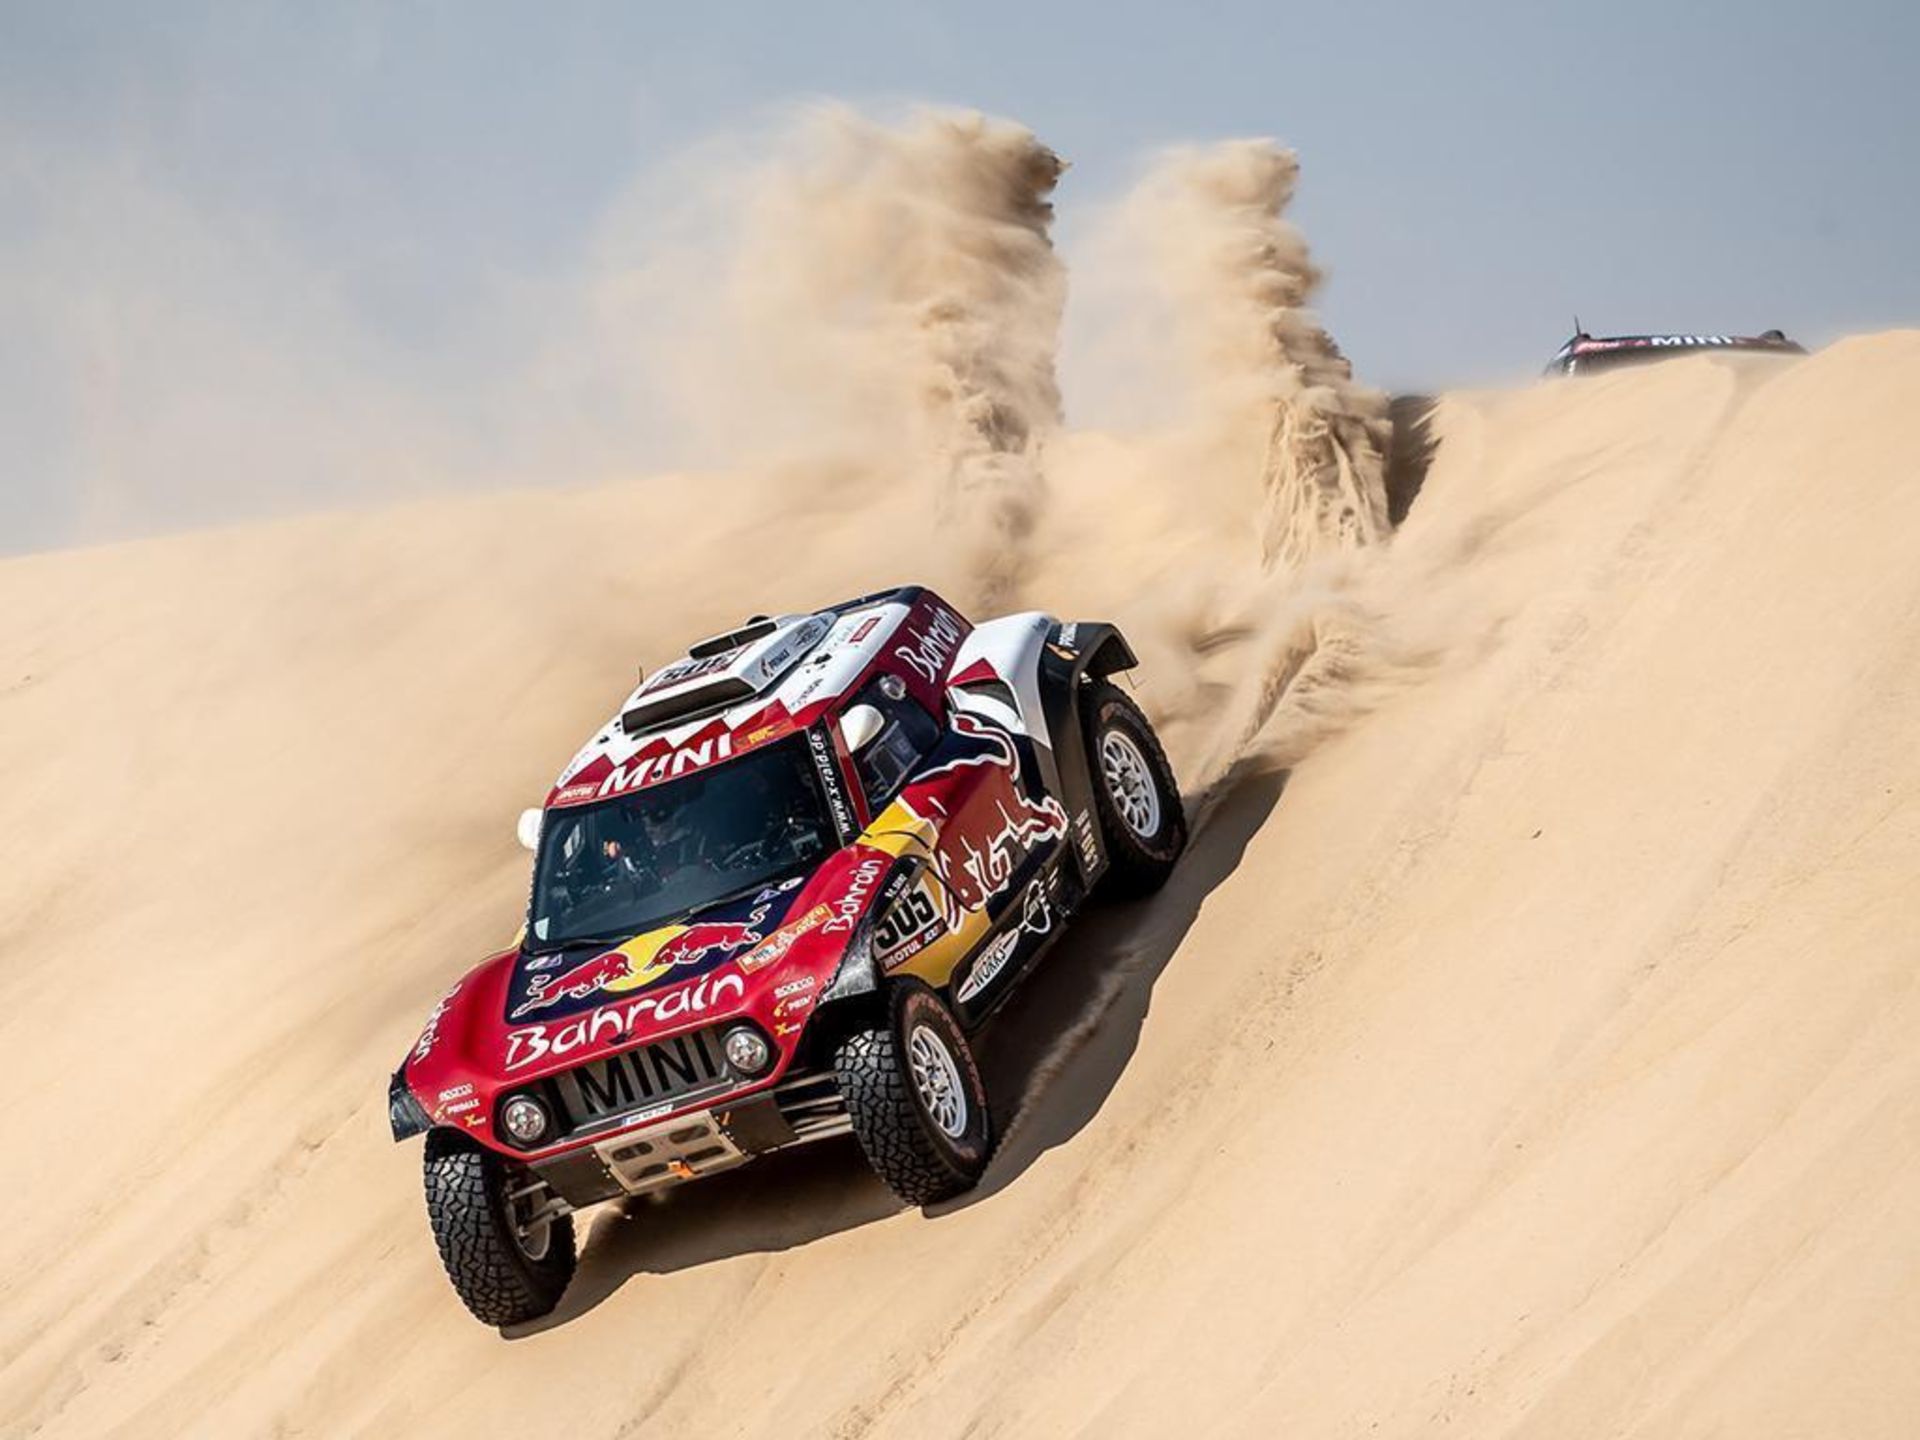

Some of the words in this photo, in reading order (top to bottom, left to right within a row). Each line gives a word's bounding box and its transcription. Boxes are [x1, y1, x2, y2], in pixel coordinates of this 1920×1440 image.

[1651, 335, 1732, 347] MINI
[895, 603, 961, 684] Bahrain
[600, 732, 733, 797] MINI
[821, 858, 884, 934] Bahrain
[504, 972, 745, 1073] Bahrain
[572, 1029, 718, 1115] MINI
